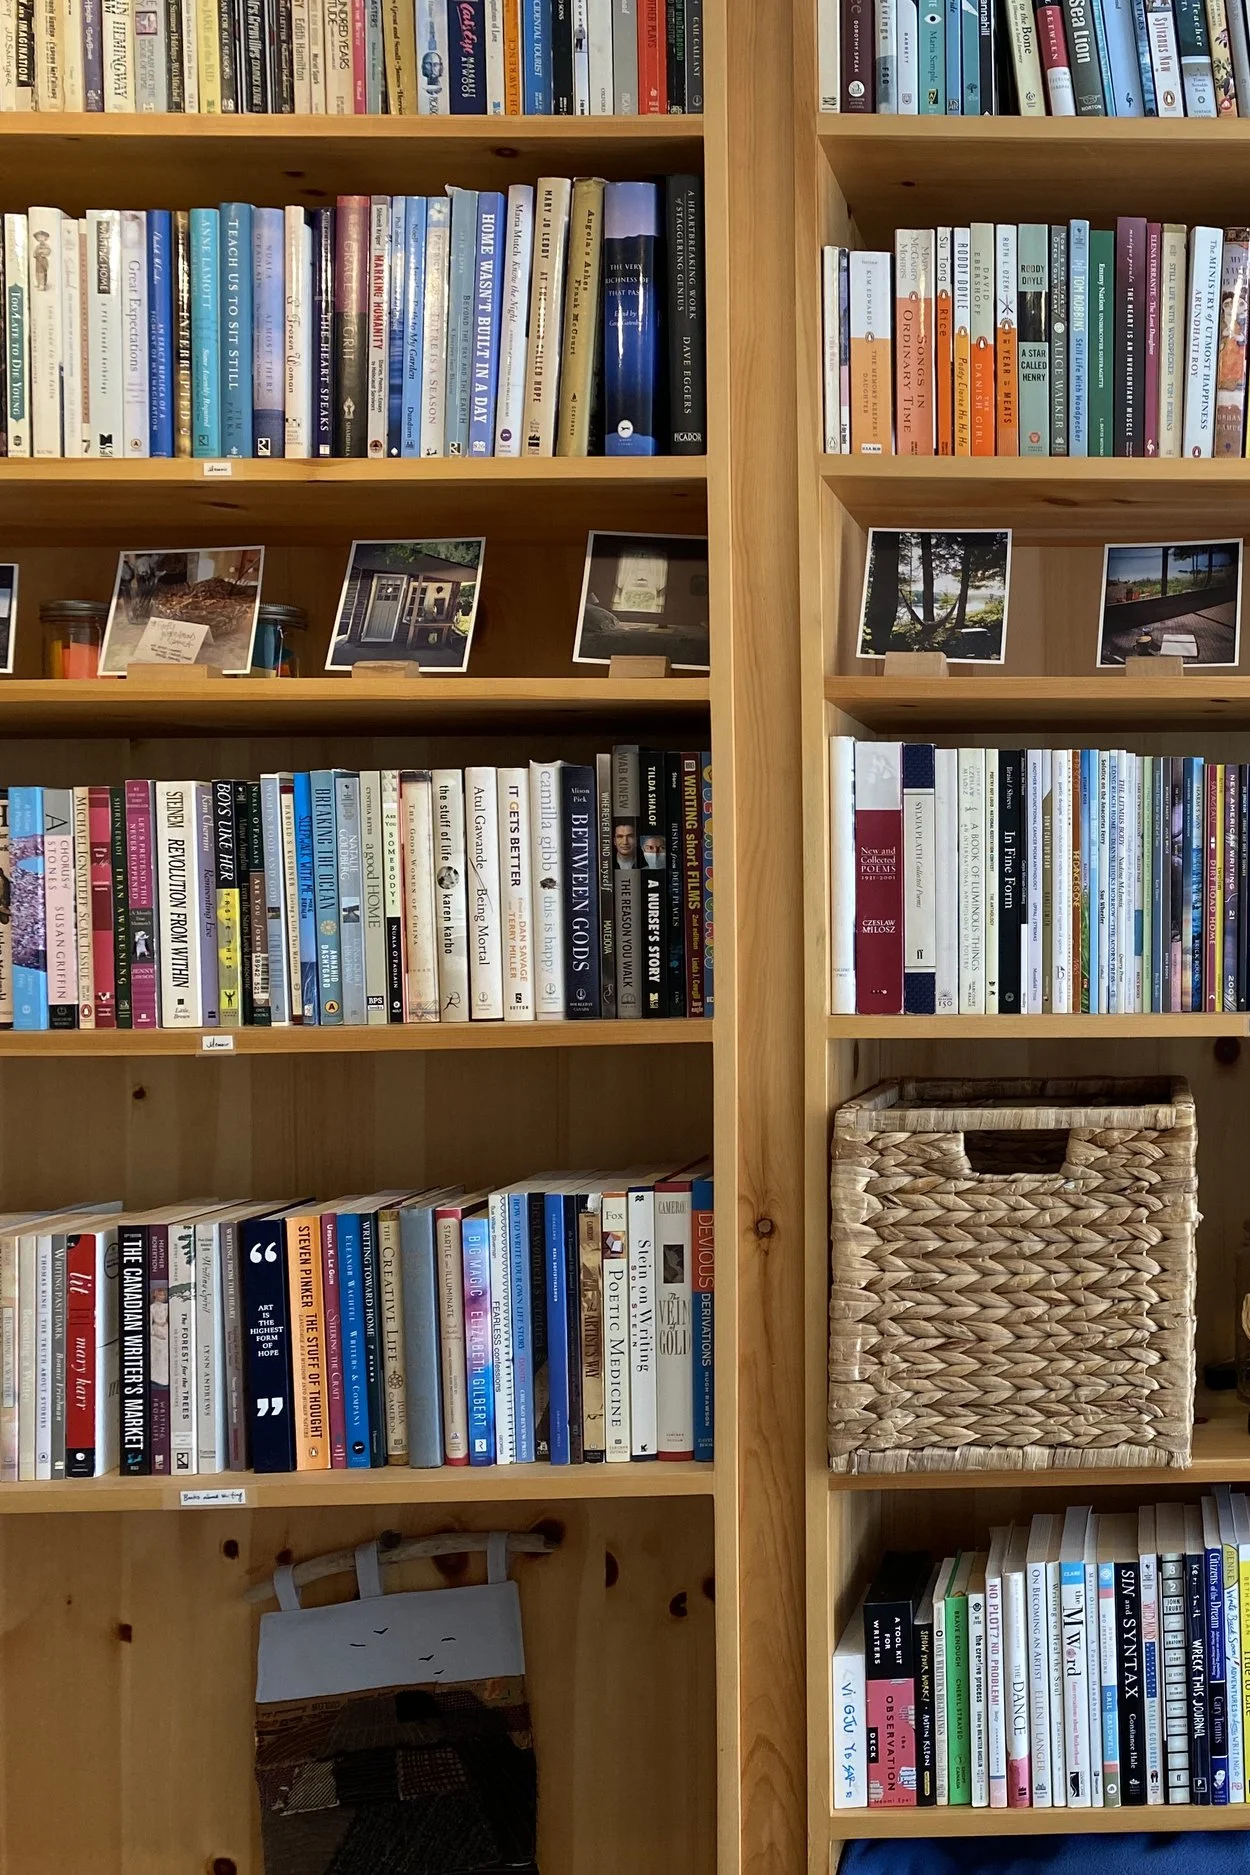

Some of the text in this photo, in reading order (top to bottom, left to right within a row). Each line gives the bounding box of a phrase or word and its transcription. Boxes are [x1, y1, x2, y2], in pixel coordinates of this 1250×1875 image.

[18, 20, 28, 81] IMAGINATION
[112, 21, 128, 98] HEMINGWAY
[938, 236, 948, 282] Su Tong
[128, 260, 141, 372] Great Expectations
[227, 219, 239, 390] TEACH US TO SIT STILL
[372, 255, 384, 350] MARKING HUMANITY
[474, 214, 494, 423] HOME WASN'T BUILT IN A DAY
[939, 308, 948, 336] Rice
[682, 336, 691, 414] DAVE EGGERS
[1021, 362, 1047, 370] CALLED
[1022, 350, 1046, 358] A STAR
[1023, 374, 1046, 382] HENRY
[674, 432, 701, 442] PICADOR
[315, 789, 335, 910] BREAKING THE OCEAN
[509, 785, 521, 887] IT GETS BETTER
[684, 775, 700, 910] WRITING short FILMS
[861, 847, 895, 855] New and
[861, 856, 896, 864] Collected
[1005, 832, 1015, 908] In Fine Form
[166, 791, 189, 988] STEINEM REVOLUTION FROM WITHIN
[571, 813, 590, 972] BETWEEN GODS
[648, 880, 660, 982] A NURSE'S STORY
[606, 1211, 623, 1220] Fox
[298, 1226, 313, 1308] STEVEN PINKER
[69, 1271, 92, 1411] lit mary karr
[123, 1239, 143, 1450] THE CANADIAN WRITER'S MARKET
[608, 1270, 625, 1427] POETIC MEDICINE
[1121, 1570, 1135, 1596] SIN
[1123, 1619, 1138, 1699] SYNTAX
[886, 1696, 895, 1791] OBSERVATION
